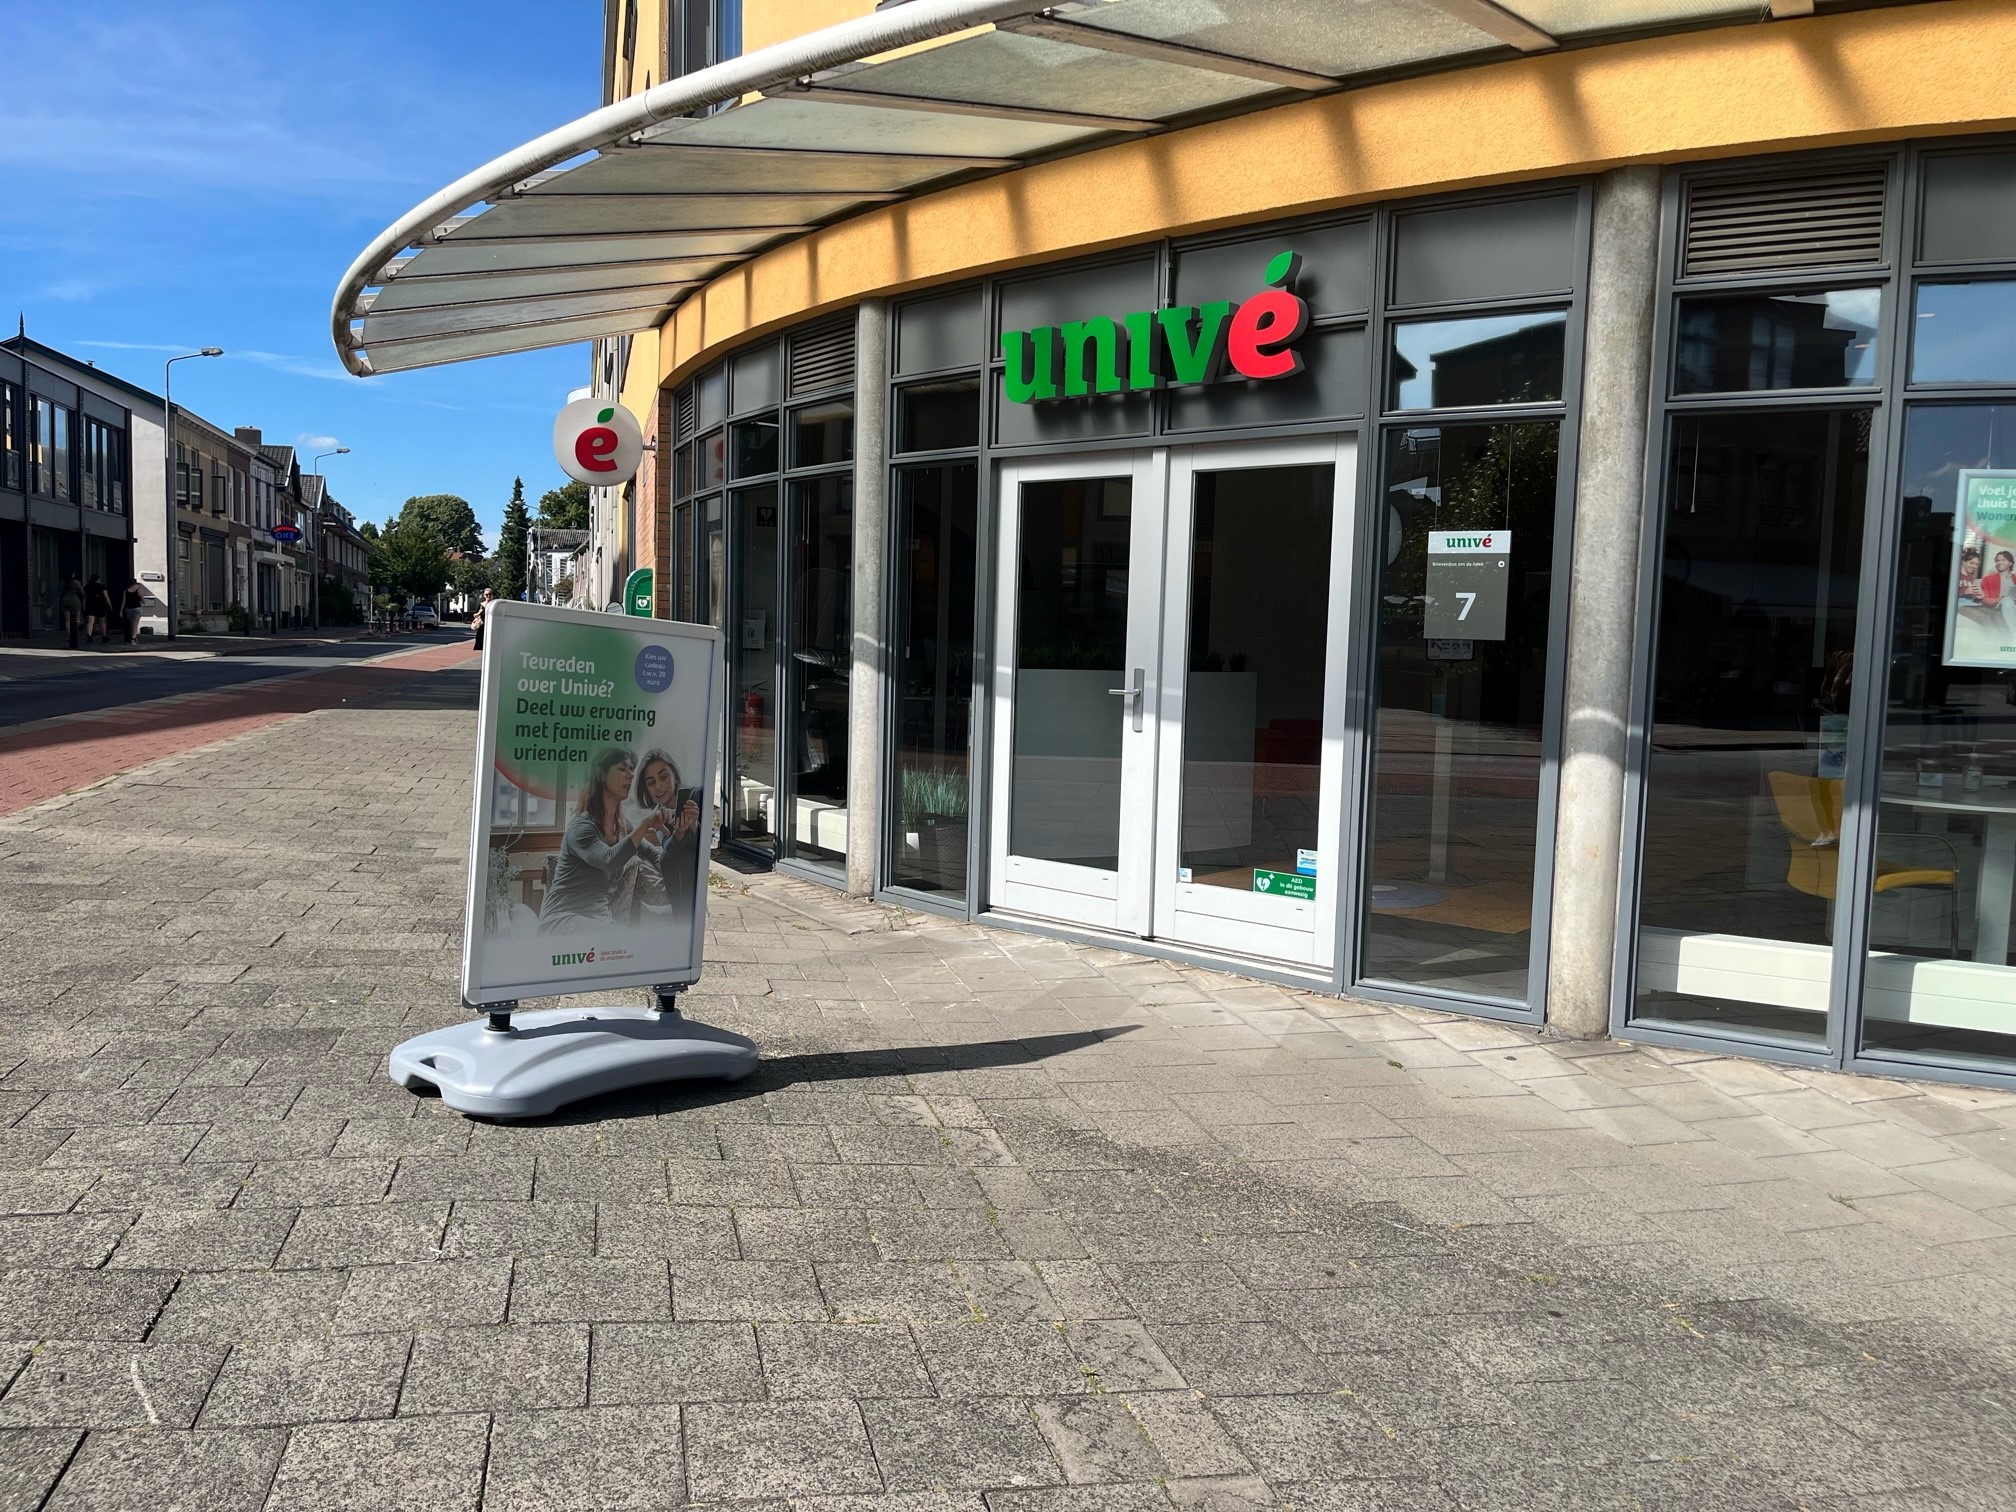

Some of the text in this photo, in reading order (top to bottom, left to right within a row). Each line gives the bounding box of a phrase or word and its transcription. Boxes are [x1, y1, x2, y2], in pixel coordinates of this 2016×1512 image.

[1001, 250, 1304, 404] univé
[1979, 485, 2005, 496] Voel
[1977, 498, 2008, 508] thuis
[1446, 533, 1492, 548] univé
[1455, 592, 1477, 621] 7
[519, 652, 595, 674] Tevreden
[517, 678, 615, 698] over Univé?
[516, 698, 656, 727] Deel uw ervaring
[515, 722, 633, 743] met familie en
[514, 744, 588, 762] vrienden
[1285, 890, 1308, 898] aanwezig
[551, 947, 595, 966] univé
